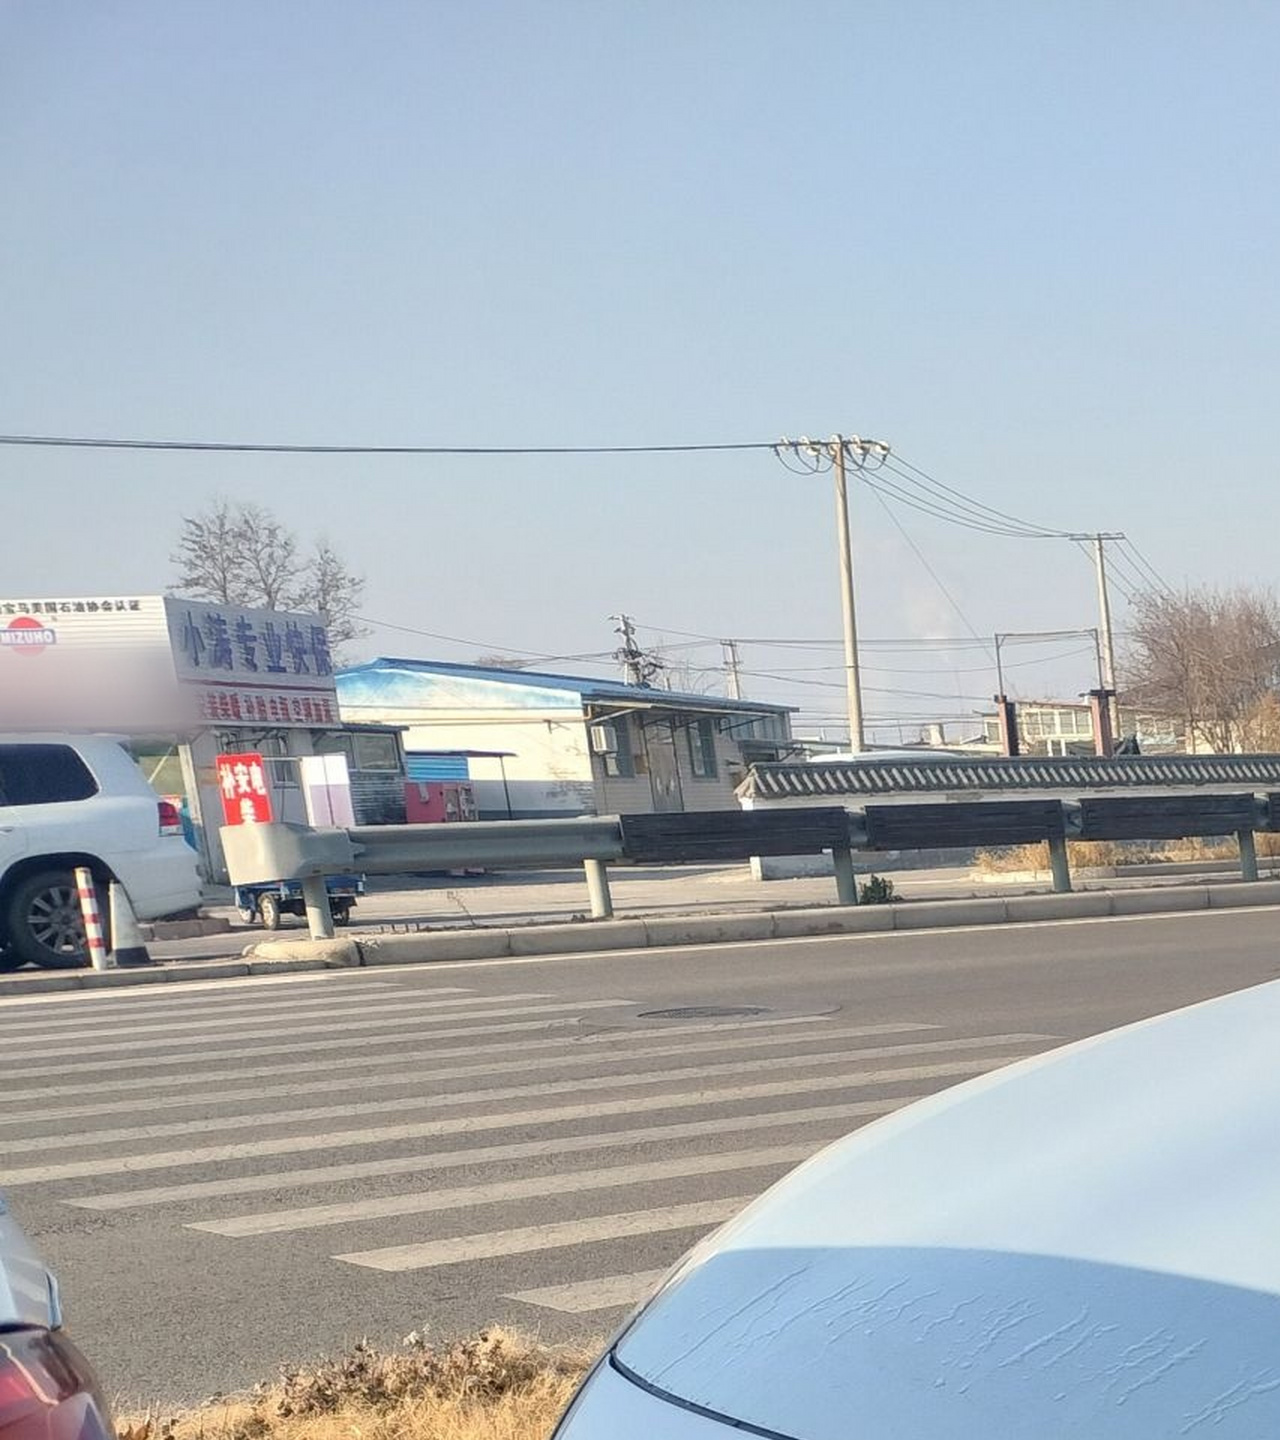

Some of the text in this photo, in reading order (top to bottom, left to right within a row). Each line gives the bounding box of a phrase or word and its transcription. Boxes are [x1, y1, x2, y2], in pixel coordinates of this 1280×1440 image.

[0, 600, 141, 614] 宝马美国石油协会认证
